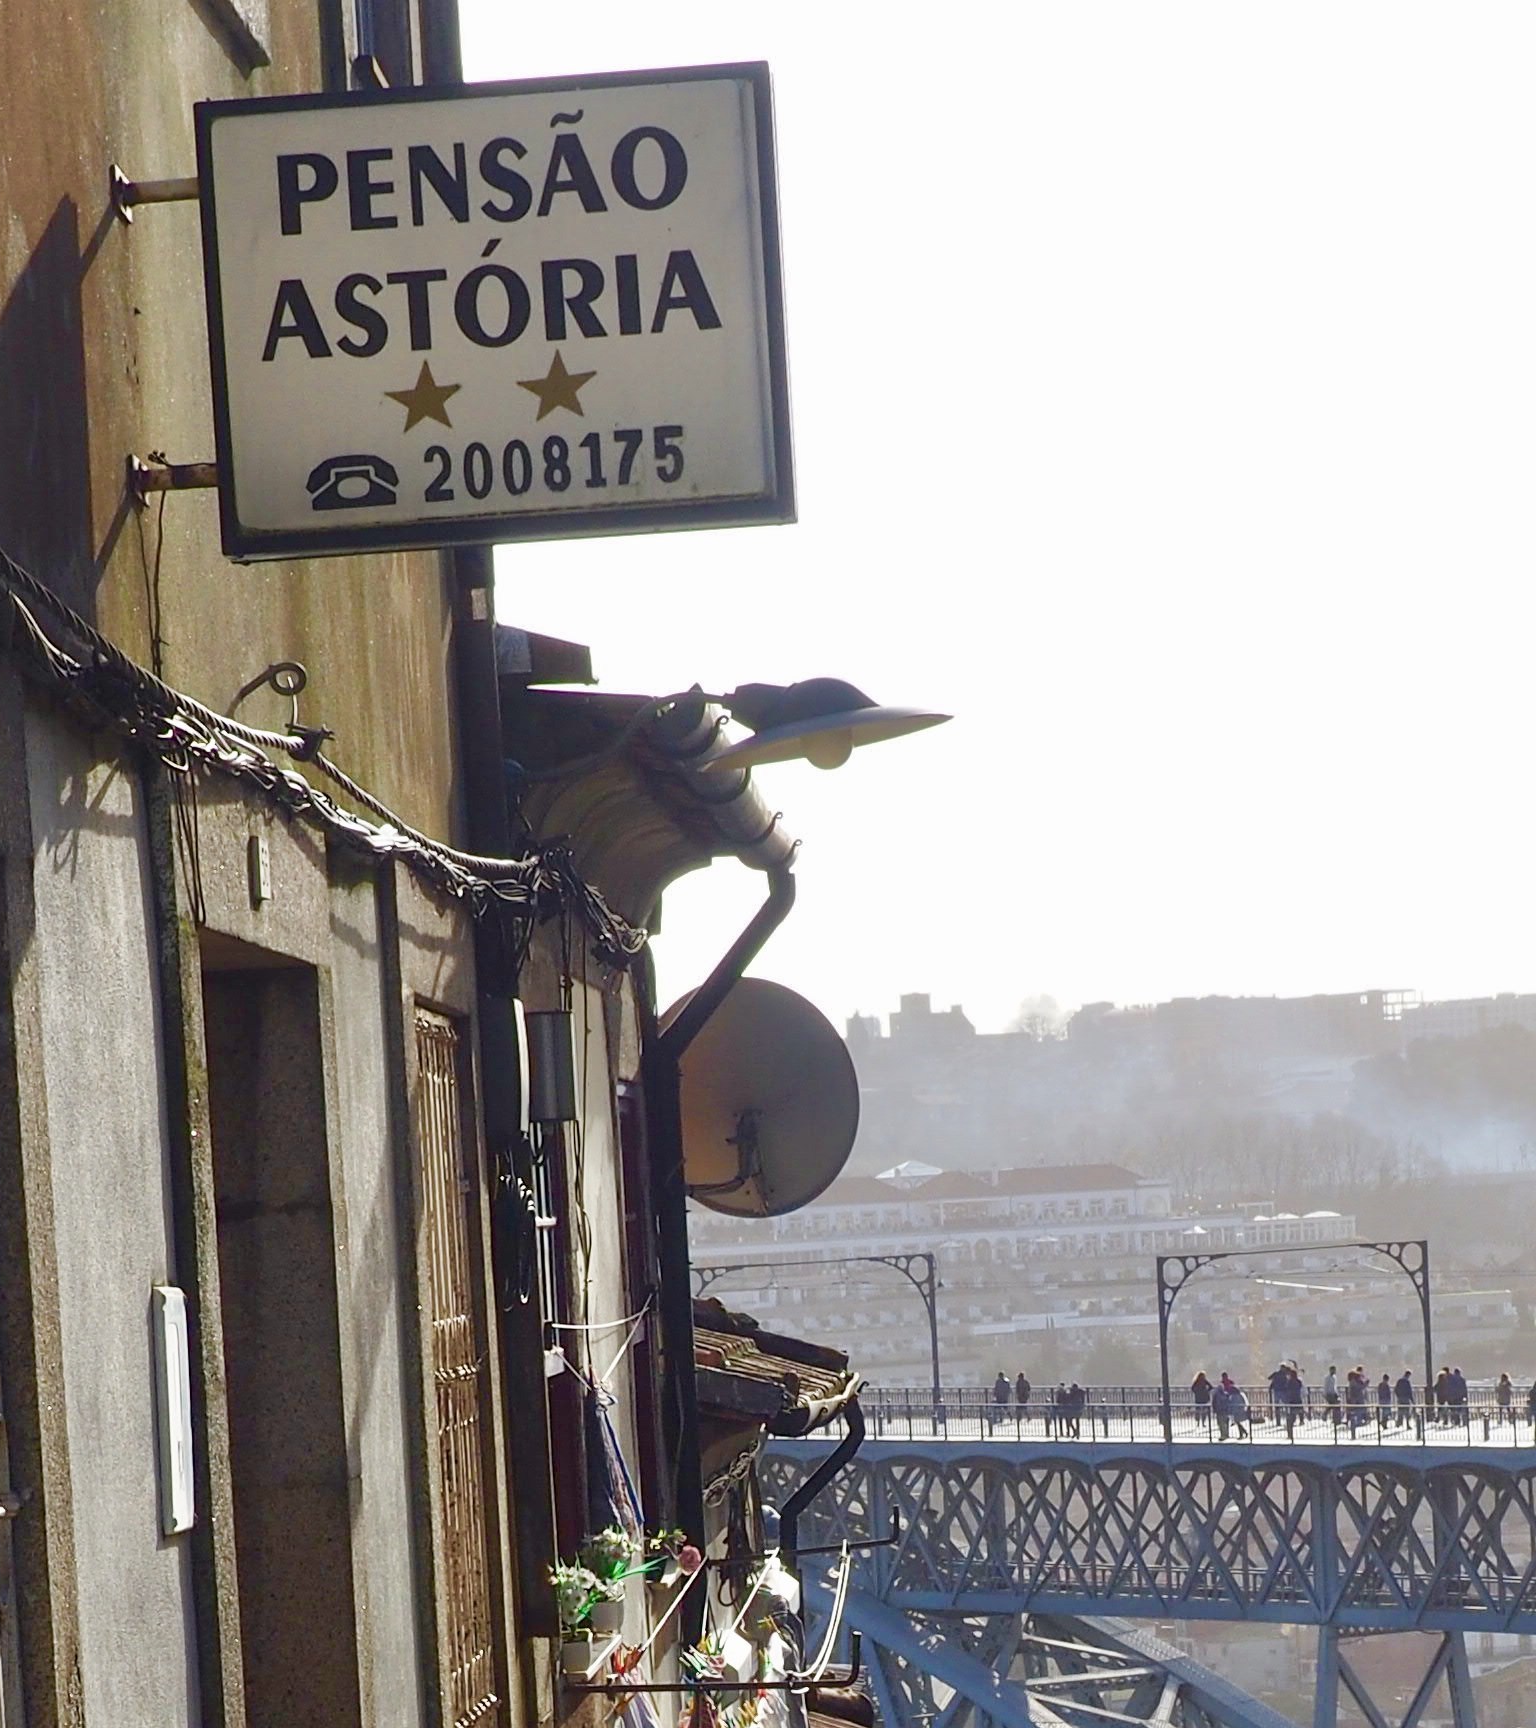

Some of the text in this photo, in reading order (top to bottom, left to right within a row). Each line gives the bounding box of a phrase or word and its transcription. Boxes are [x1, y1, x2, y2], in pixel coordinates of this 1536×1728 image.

[275, 108, 689, 236] PENSÃO
[261, 237, 723, 362] ASTÓRIA
[423, 424, 685, 503] 2008175
